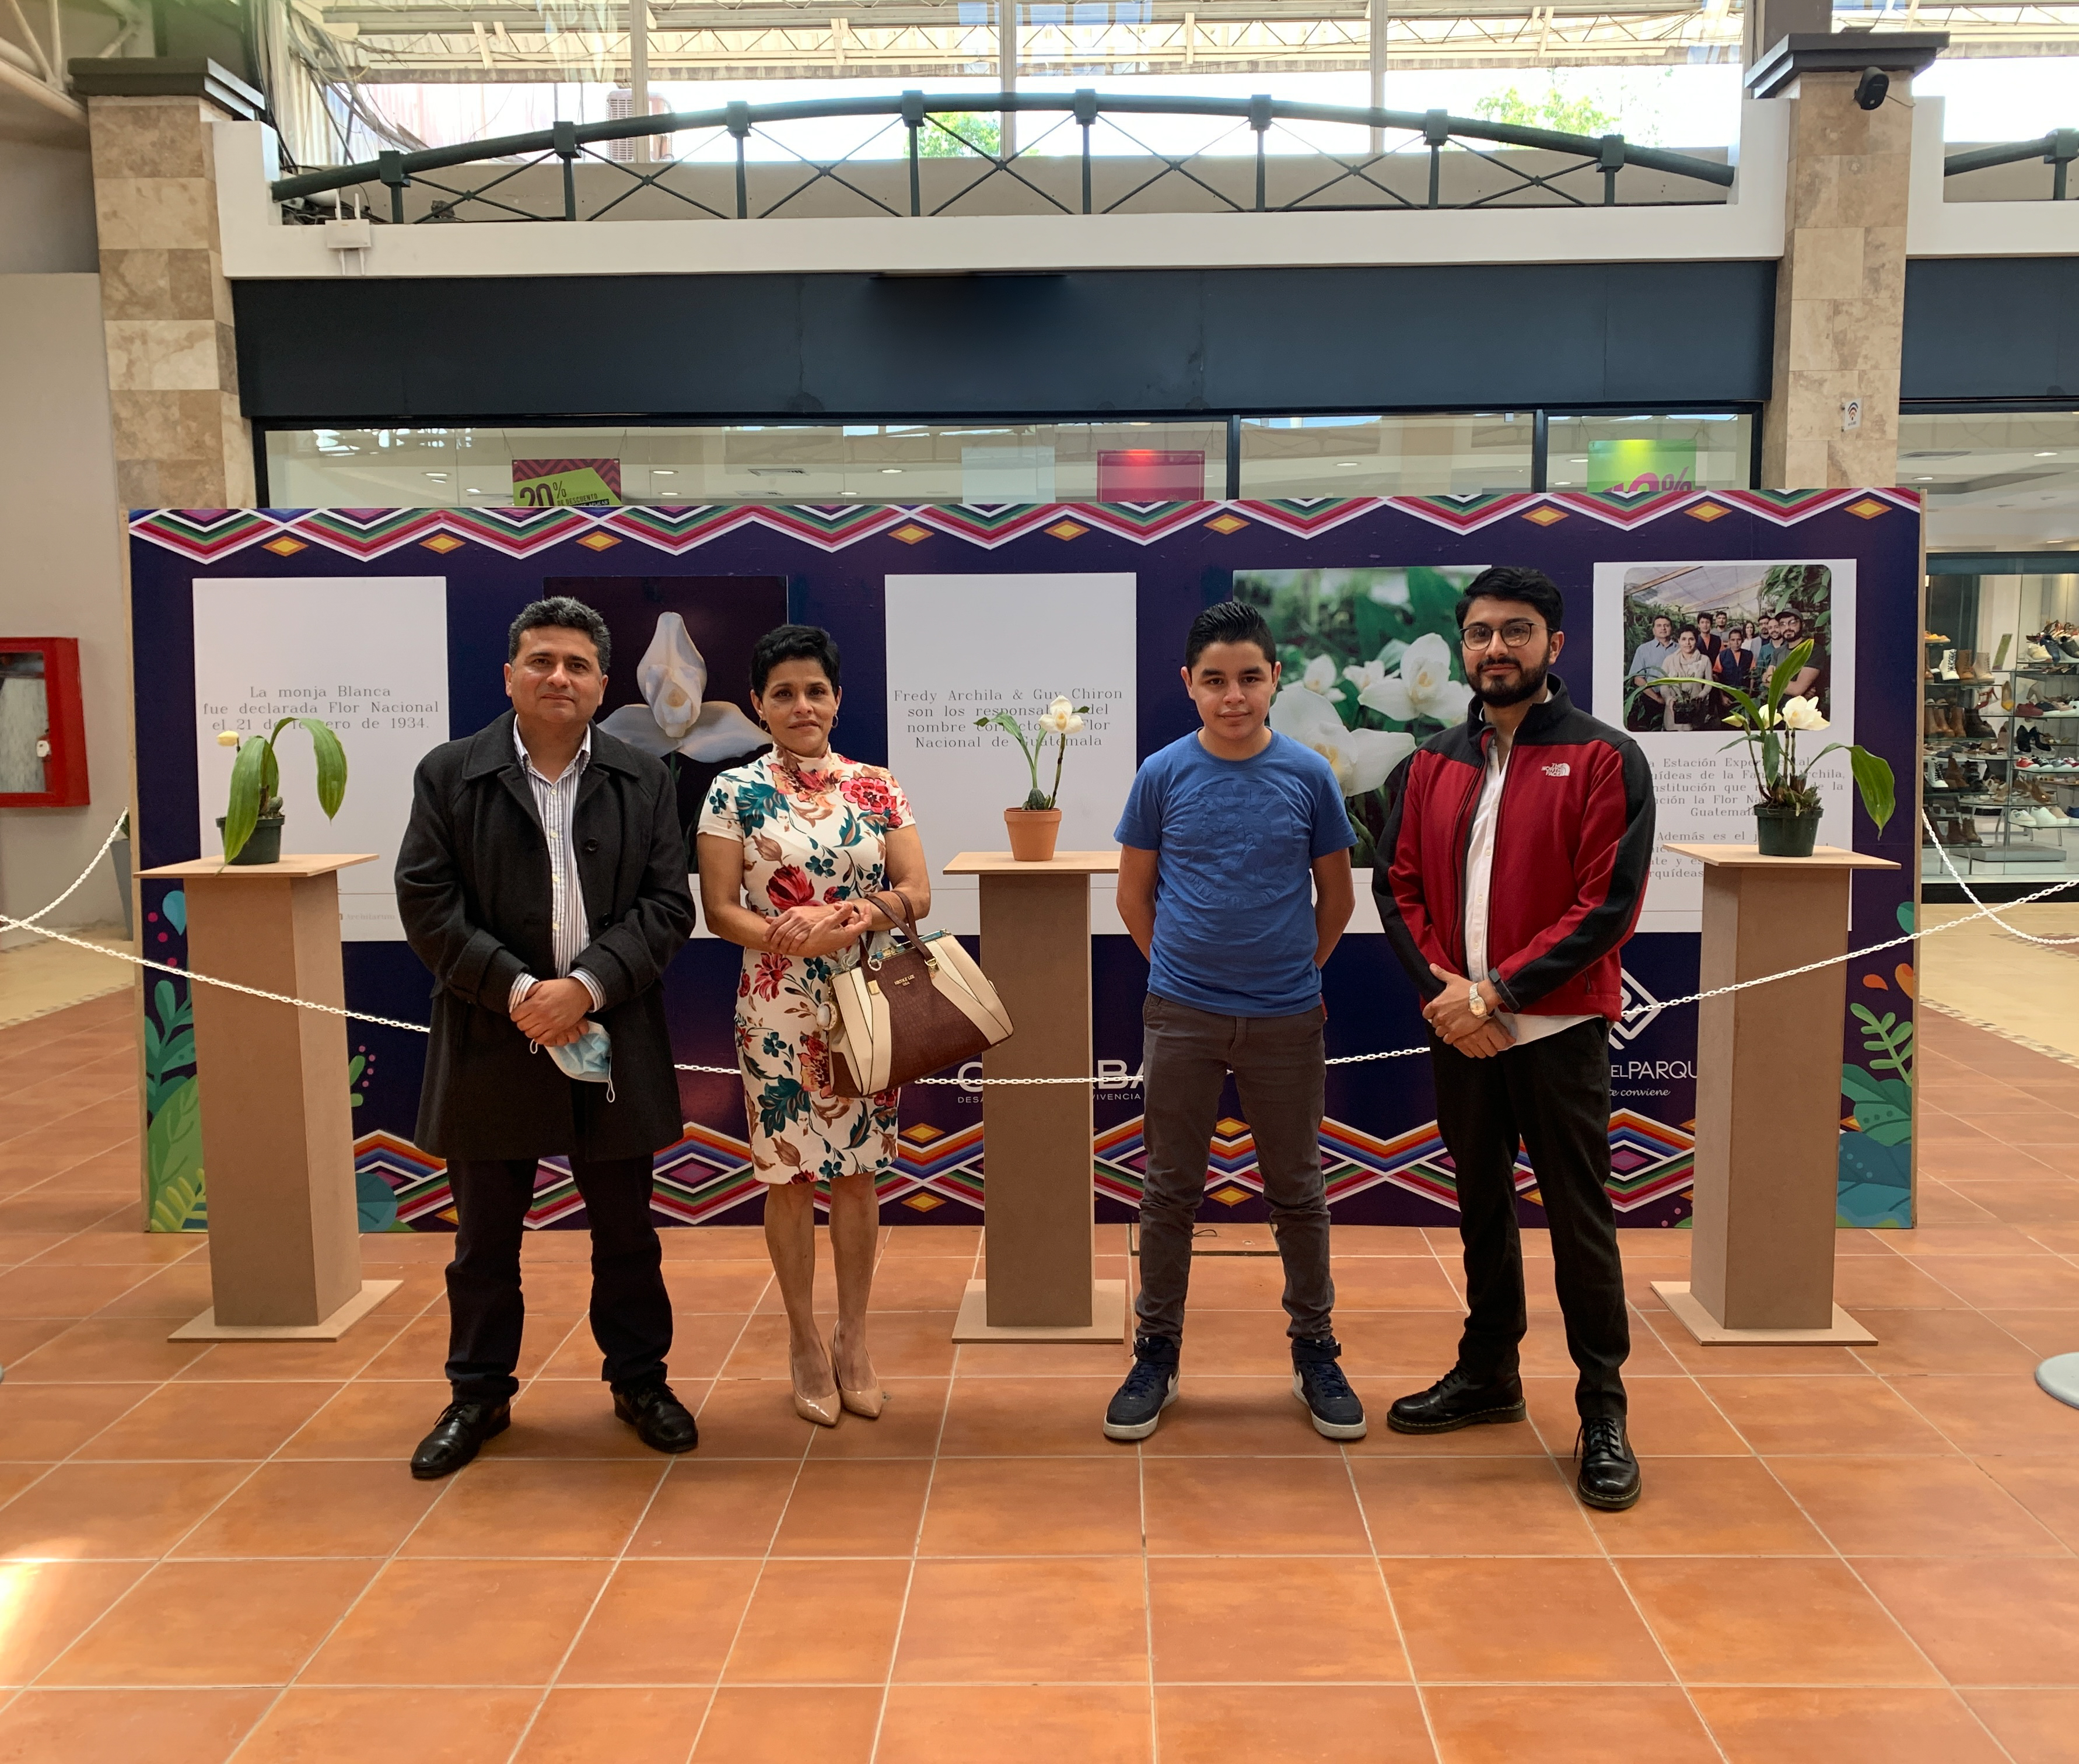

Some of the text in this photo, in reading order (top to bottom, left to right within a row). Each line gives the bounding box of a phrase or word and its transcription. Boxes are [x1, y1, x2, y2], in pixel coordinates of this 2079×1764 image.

[565, 494, 598, 505] DESCUENTO
[250, 685, 391, 700] La monja Blanca
[894, 690, 937, 704] Fredy
[948, 690, 1002, 701] Archila
[1013, 689, 1023, 700] &
[1072, 688, 1123, 699] Chiron
[204, 701, 438, 715] fue declarada Flor Nacional
[908, 708, 933, 717] son
[944, 705, 965, 716] los
[212, 719, 225, 730] el
[236, 719, 251, 730] 21
[362, 718, 379, 729] de
[391, 717, 429, 729] 1934.
[907, 722, 966, 733] nombre
[916, 736, 981, 748] Nacional
[992, 736, 1009, 747] de
[1664, 758, 1716, 768] Estación
[1700, 771, 1715, 780] de
[1723, 770, 1734, 779] la
[1653, 783, 1716, 792] nstitución
[1724, 785, 1746, 794] que
[1833, 782, 1843, 790] la
[1695, 795, 1704, 804] la
[1714, 794, 1738, 804] Flor
[1657, 831, 1705, 841] Además
[1734, 831, 1745, 840] el
[1676, 858, 1682, 867] y
[1620, 1088, 1671, 1097] conviene
